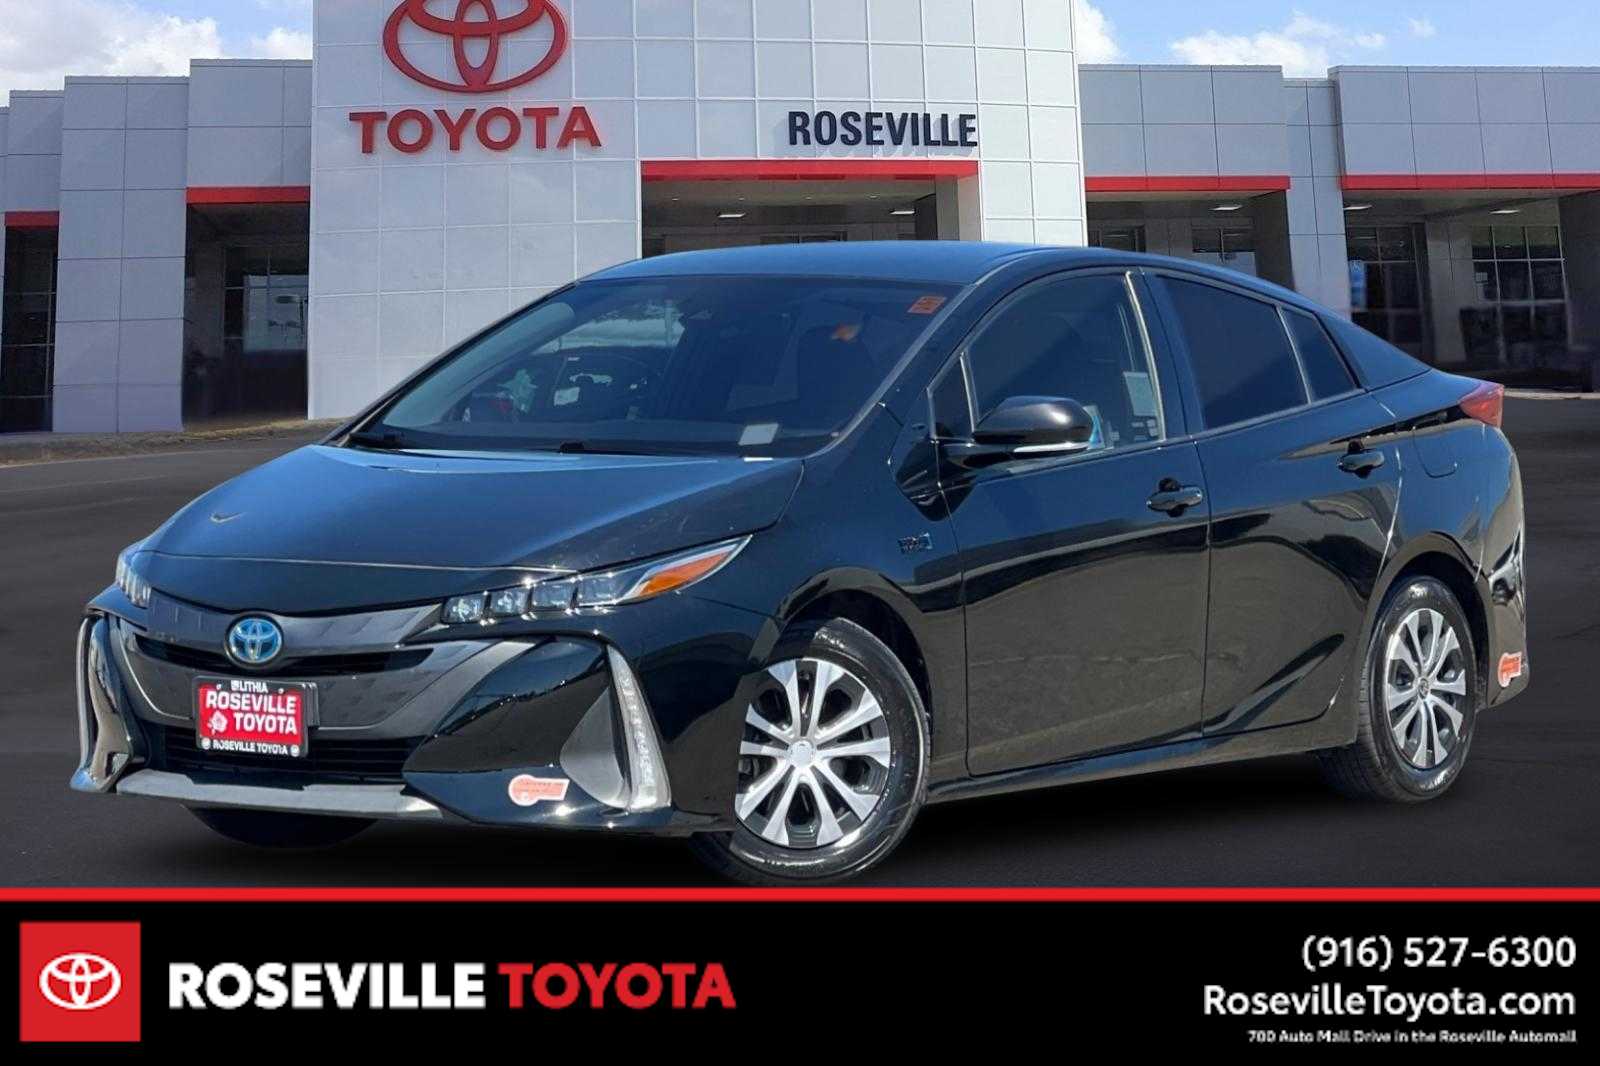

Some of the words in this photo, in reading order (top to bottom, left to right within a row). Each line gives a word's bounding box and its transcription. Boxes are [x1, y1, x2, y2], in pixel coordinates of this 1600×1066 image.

[349, 106, 601, 154] TOYOTA
[788, 111, 978, 147] ROSEVILLE
[239, 680, 268, 693] LITHIA
[205, 690, 298, 714] ROSEVILLE
[233, 712, 298, 735] TOYOTA
[212, 740, 256, 752] ROSEVILLE
[257, 742, 288, 755] TOYOTA
